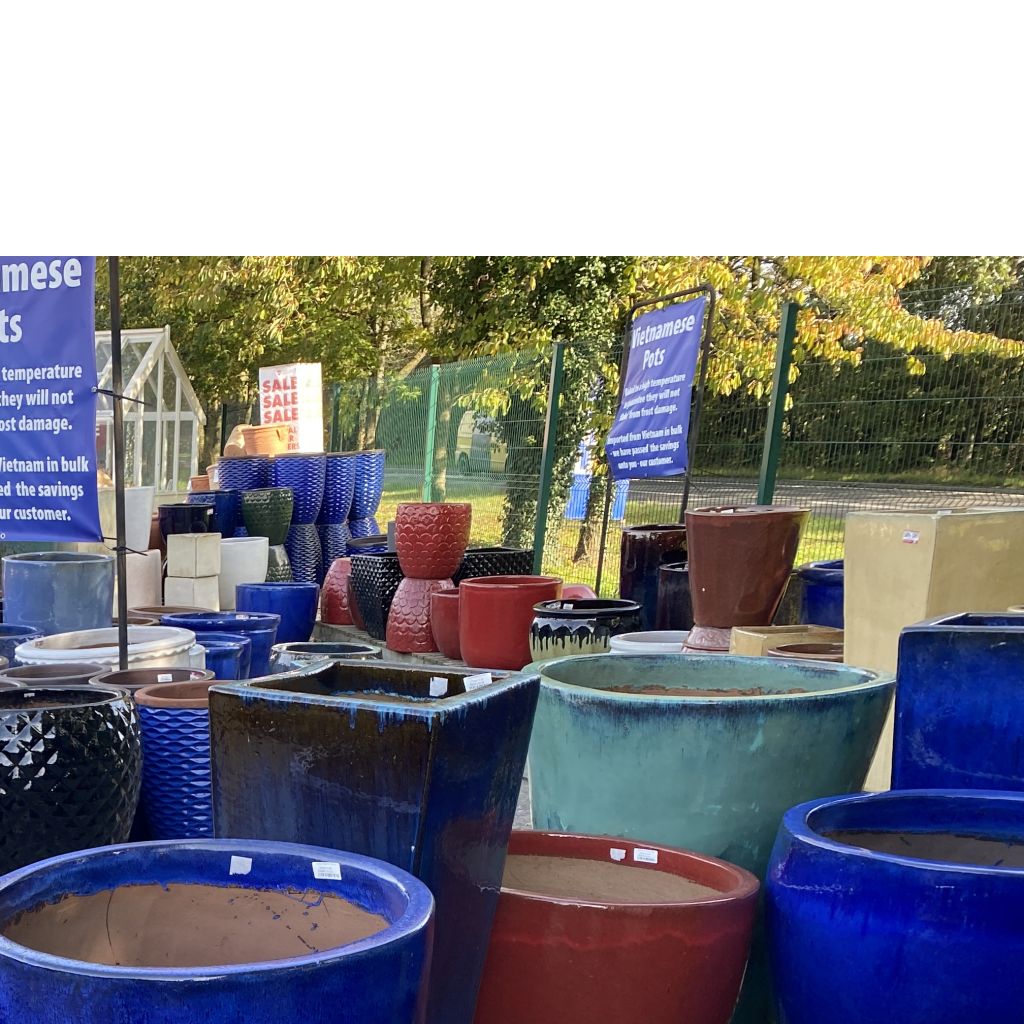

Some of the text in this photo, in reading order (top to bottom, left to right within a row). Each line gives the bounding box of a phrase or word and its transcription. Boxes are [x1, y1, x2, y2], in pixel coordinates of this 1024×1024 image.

[632, 314, 696, 348] Vietnamese
[642, 348, 666, 370] Pots
[2, 364, 82, 385] temperature
[262, 376, 298, 393] SALE
[25, 389, 49, 406] will
[51, 390, 74, 405] not
[263, 392, 299, 408] SALE
[263, 408, 298, 424] SALE
[18, 416, 73, 435] damage.
[47, 456, 59, 473] in
[61, 456, 89, 473] bulk
[16, 481, 36, 497] the
[38, 481, 84, 500] savings
[13, 506, 71, 521] customer.
